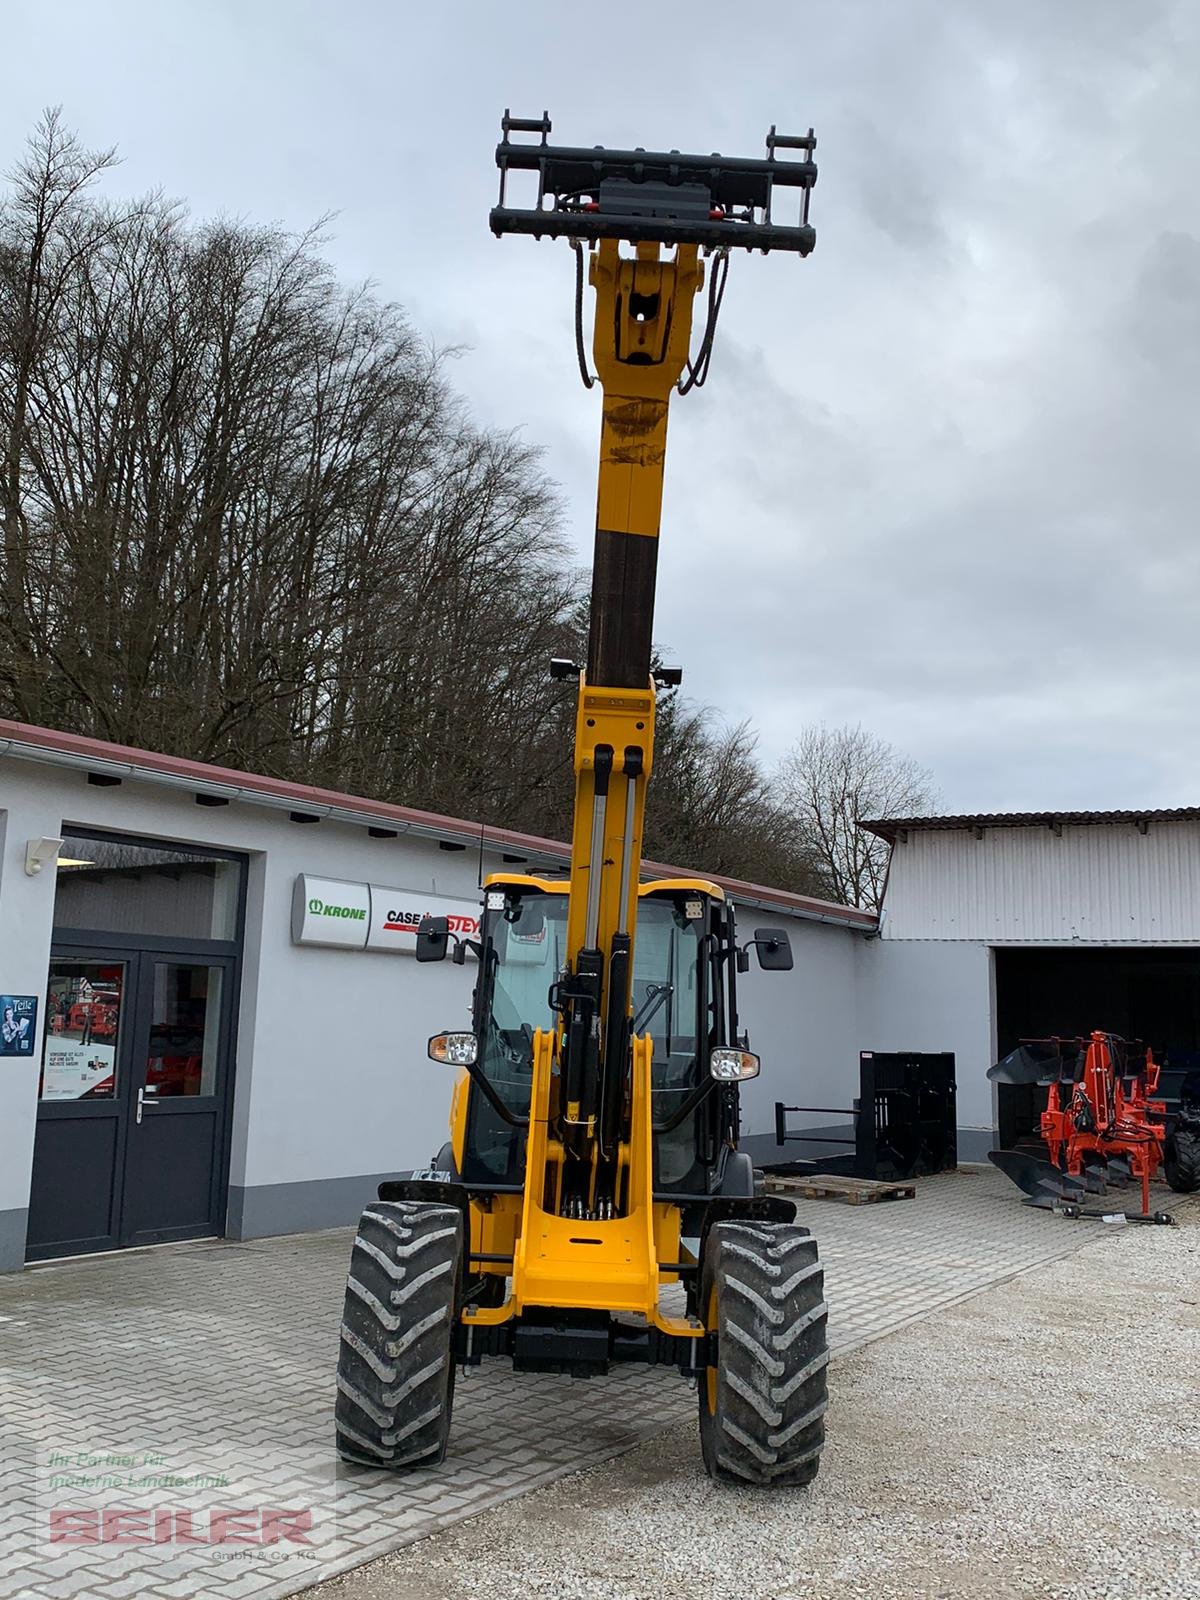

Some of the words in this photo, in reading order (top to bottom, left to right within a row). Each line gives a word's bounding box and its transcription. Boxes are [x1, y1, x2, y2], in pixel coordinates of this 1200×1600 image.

[323, 905, 367, 920] KRONE
[387, 910, 421, 925] CASE
[13, 1000, 32, 1012] Teile
